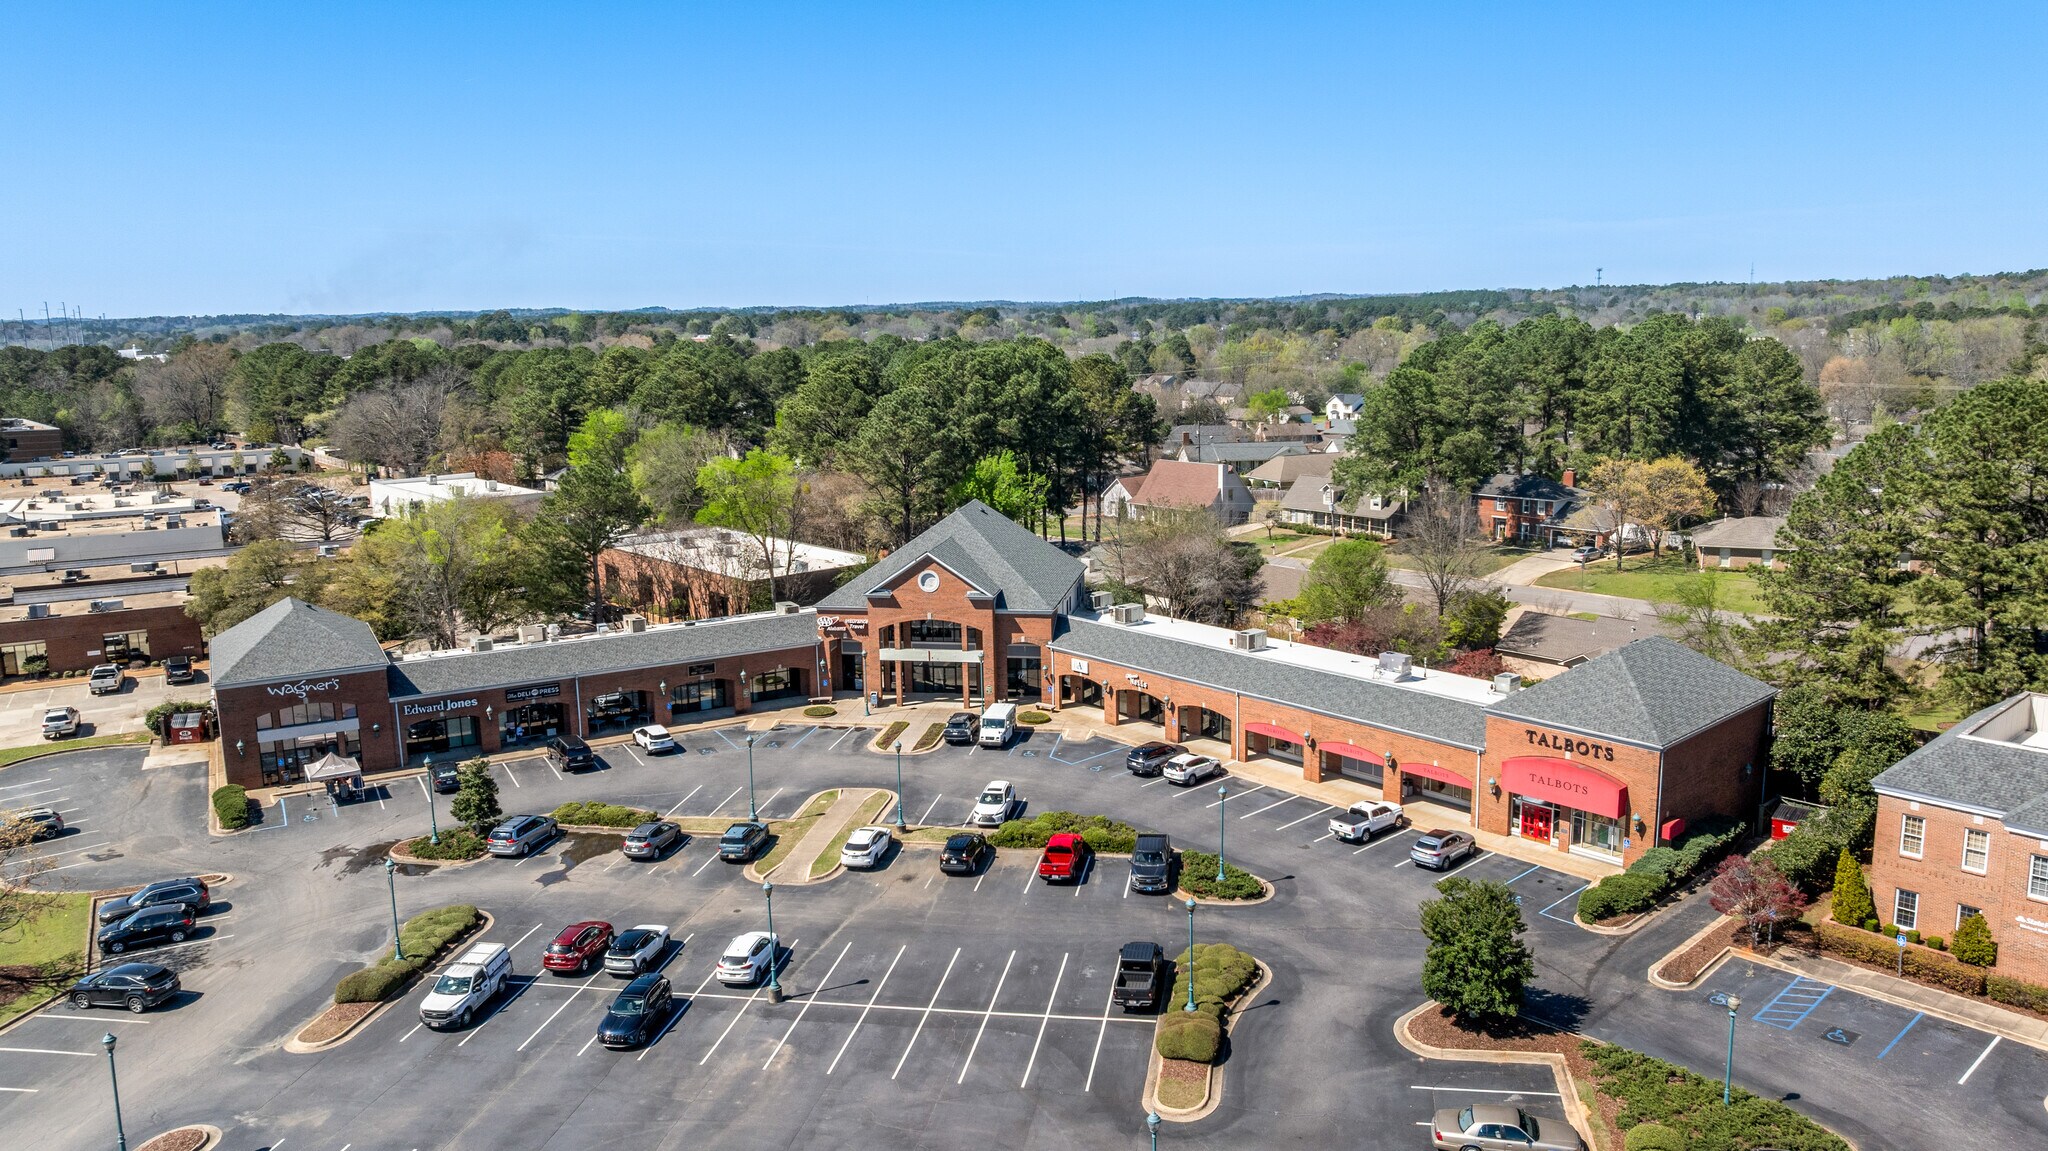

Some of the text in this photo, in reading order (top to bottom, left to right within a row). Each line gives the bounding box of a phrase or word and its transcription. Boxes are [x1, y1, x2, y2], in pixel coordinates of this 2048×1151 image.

[540, 686, 559, 695] PRESS
[404, 698, 478, 715] Edward Jones
[1525, 729, 1614, 761] TALBOTS
[1423, 767, 1449, 779] TALBOTS
[1529, 773, 1588, 795] TALBOTS
